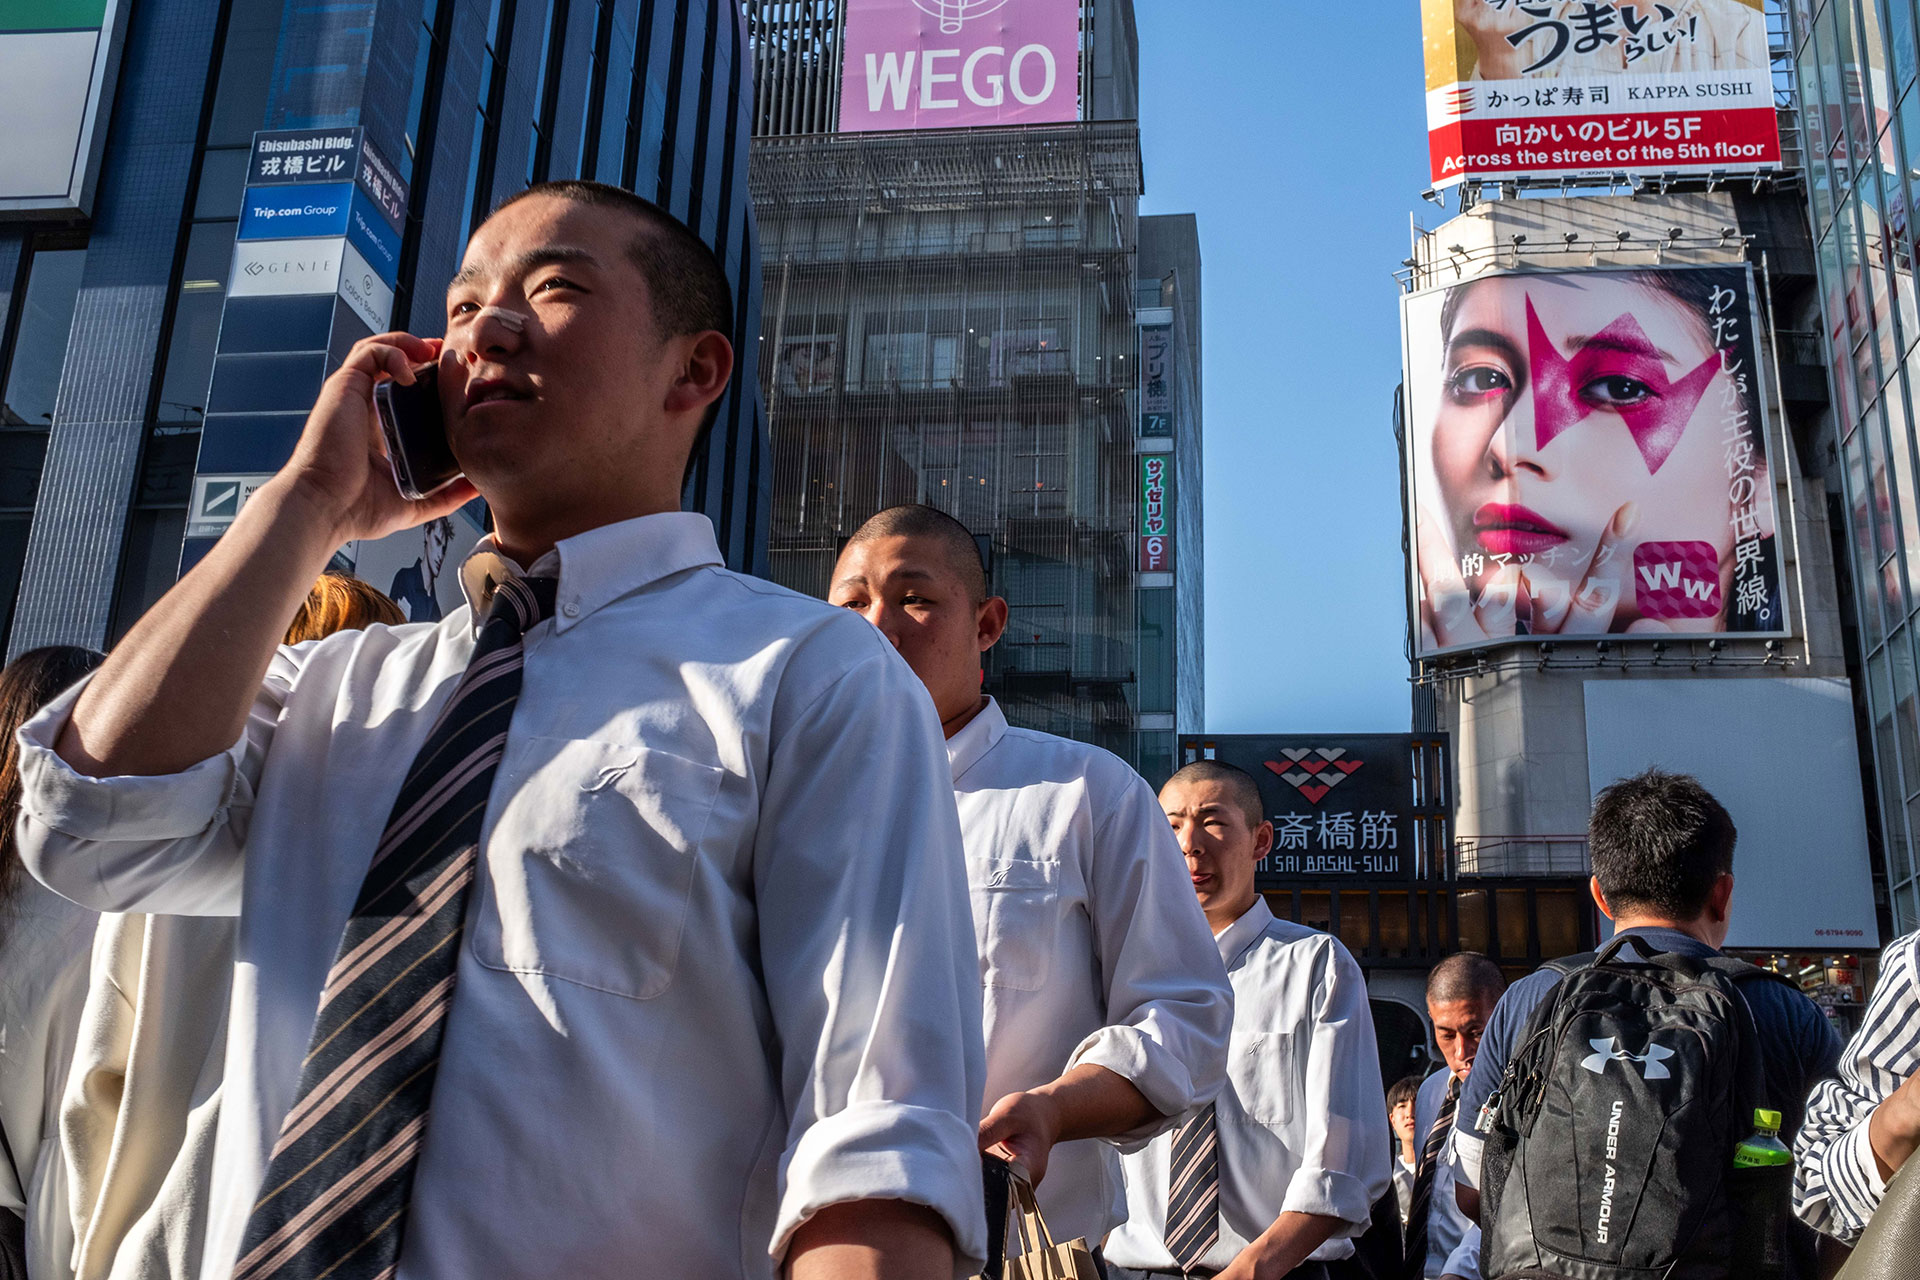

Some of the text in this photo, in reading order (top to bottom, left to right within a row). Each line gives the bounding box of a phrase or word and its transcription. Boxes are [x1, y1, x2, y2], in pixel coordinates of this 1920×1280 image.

[1506, 2, 1675, 73] うまい
[865, 43, 1057, 112] WEGO
[1628, 82, 1753, 100] KAPPA SUSHI
[1487, 86, 1610, 108] かっぱ寿司
[258, 136, 354, 152] Ebisubashi Bldg.
[1495, 117, 1702, 147] 向かいのビル 5F
[260, 154, 346, 176] 戎橋ビル
[1442, 141, 1766, 173] Across the street of the 5th floor
[361, 163, 400, 219] 戎橋ビル
[253, 205, 336, 220] Trip.com Group
[268, 261, 331, 274] GENIE
[344, 278, 363, 307] Colors
[1147, 342, 1168, 398] プリ機
[1149, 415, 1167, 429] 7F
[1708, 284, 1771, 621] わたしが主役の世界線。
[1146, 459, 1164, 533] サイゼリヤ
[1273, 810, 1398, 850] 斎橋筋
[1275, 855, 1300, 872] SAI
[1597, 1101, 1624, 1244] UNDER ARMOUR
